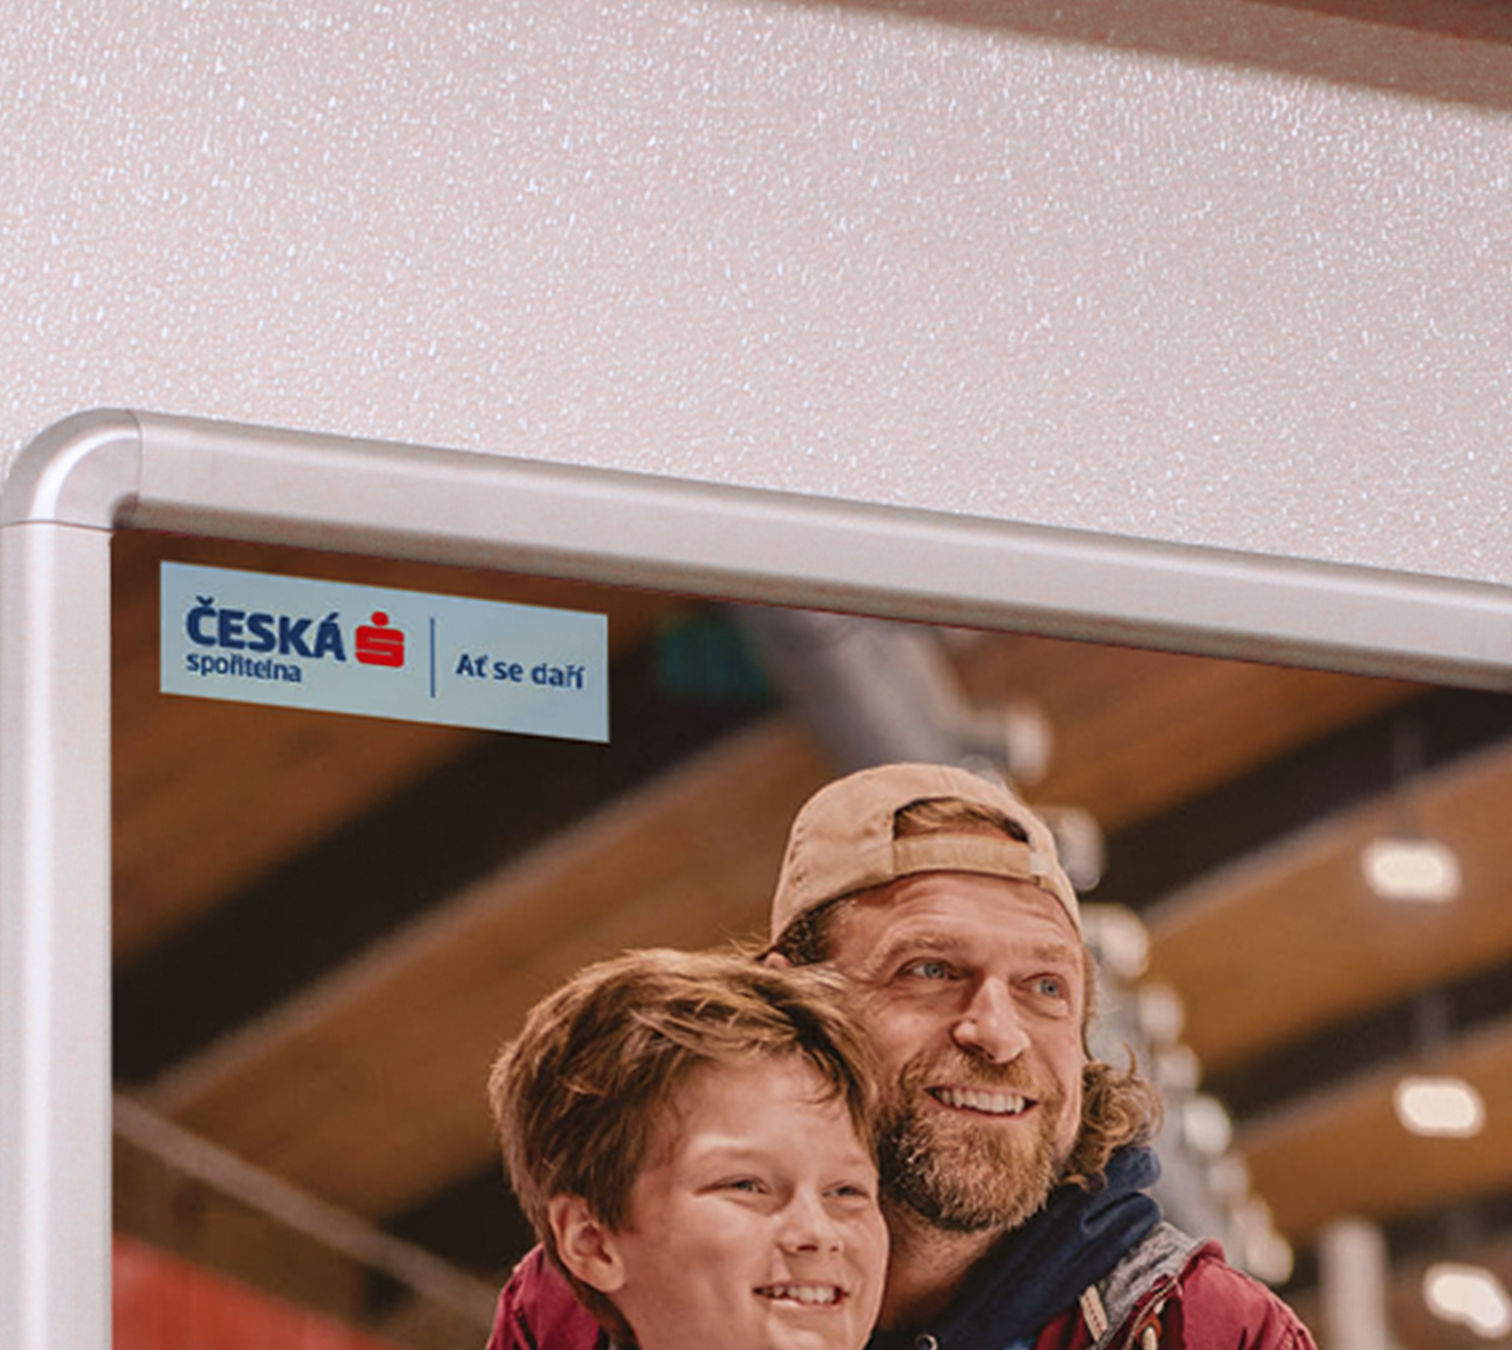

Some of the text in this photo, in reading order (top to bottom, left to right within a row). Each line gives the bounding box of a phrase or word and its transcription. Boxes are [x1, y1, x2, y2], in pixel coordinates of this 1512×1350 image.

[186, 595, 347, 662] ČESKÁ
[186, 652, 302, 682] spořitelna
[455, 653, 585, 689] Ať se daří
